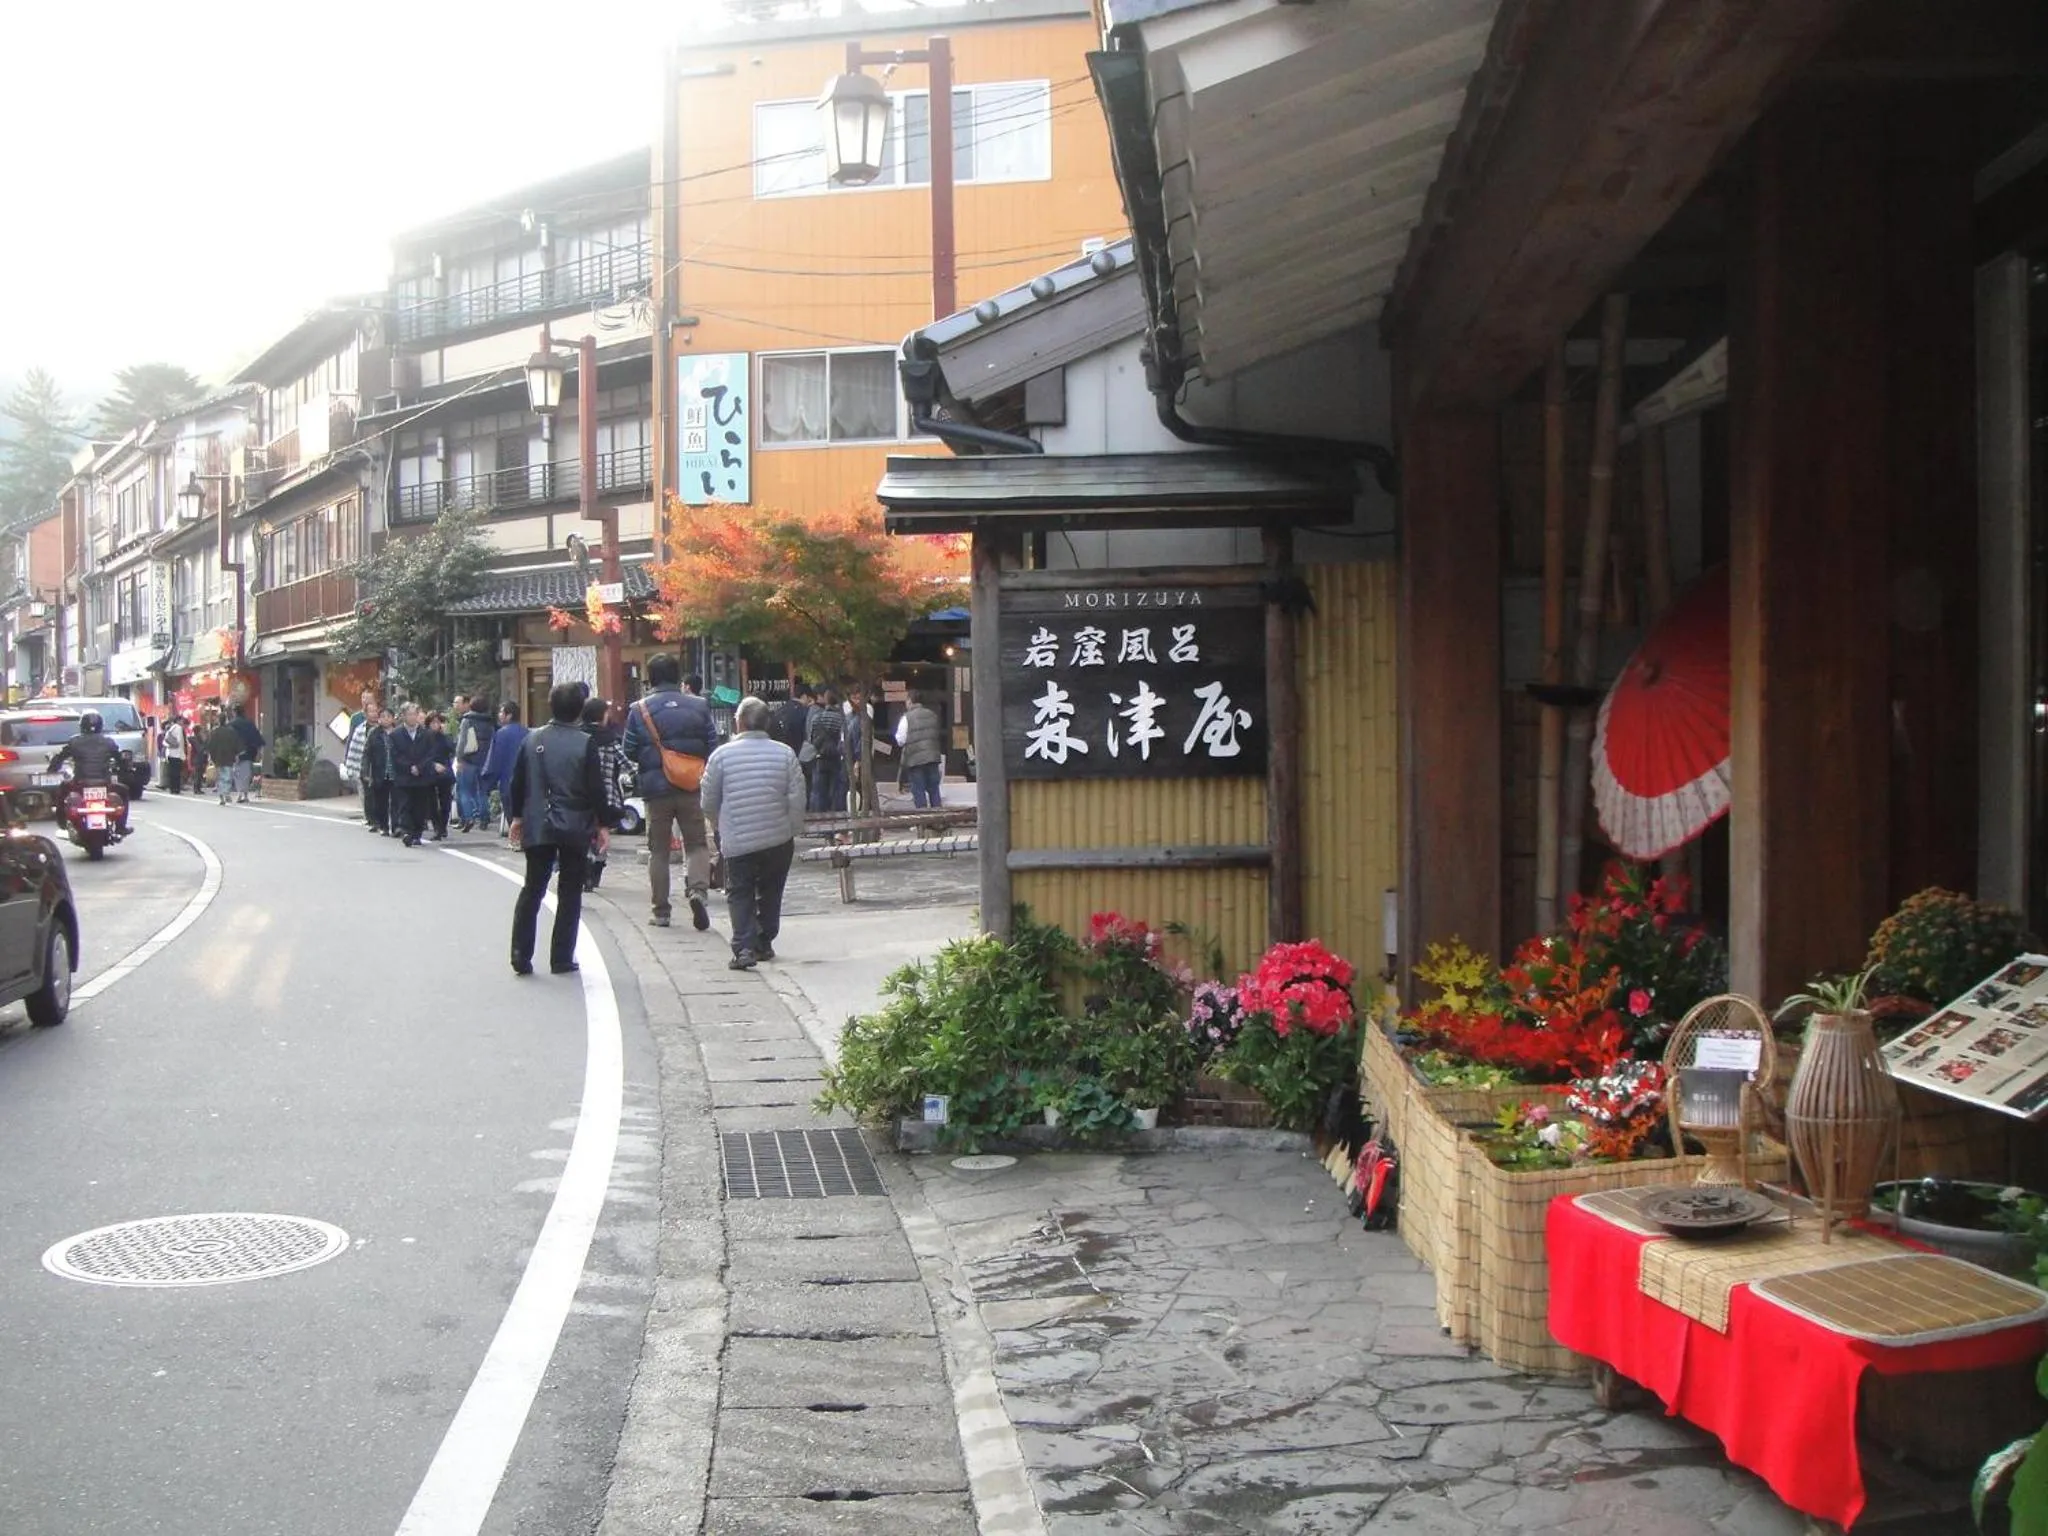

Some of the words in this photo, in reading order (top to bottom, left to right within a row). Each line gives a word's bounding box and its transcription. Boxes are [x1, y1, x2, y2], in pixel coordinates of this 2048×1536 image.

[701, 385, 742, 495] ひらい
[1064, 592, 1202, 607] MORIZUYA
[1025, 680, 1253, 765] 森津屋
